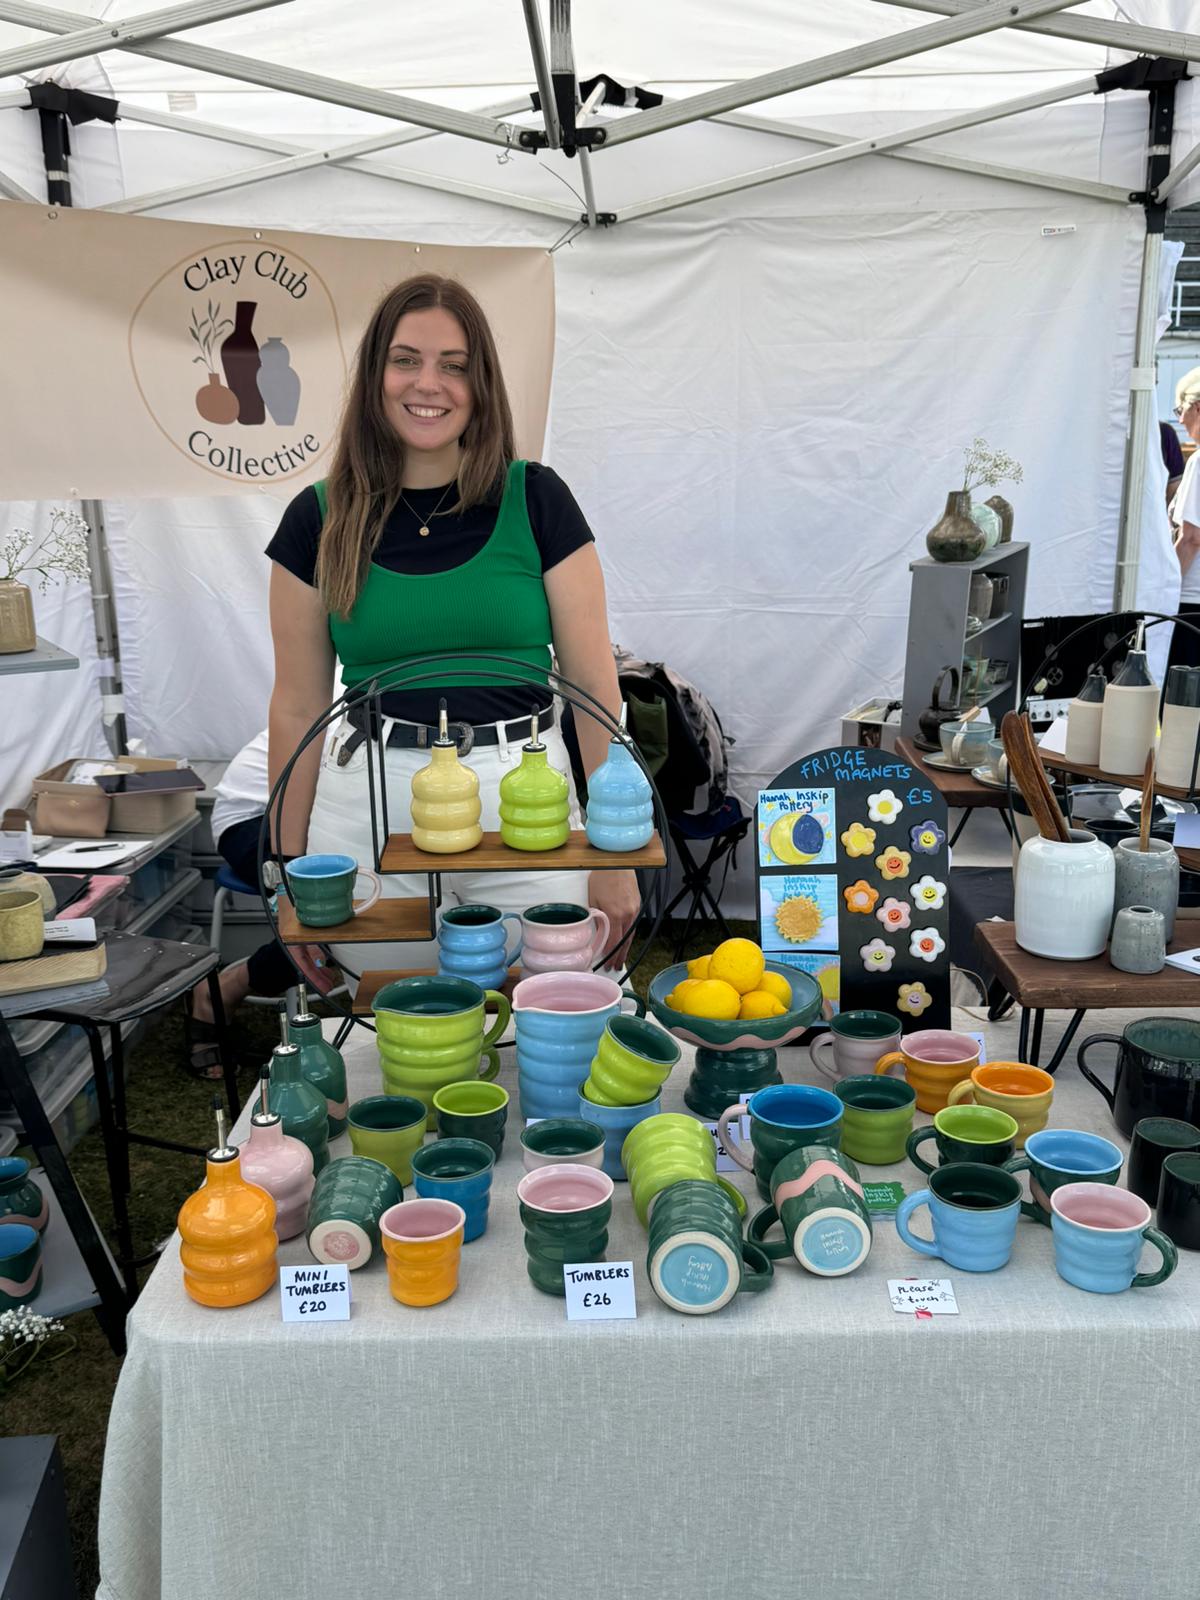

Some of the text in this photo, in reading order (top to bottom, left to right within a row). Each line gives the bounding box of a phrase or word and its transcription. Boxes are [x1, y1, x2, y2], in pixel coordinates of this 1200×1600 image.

[184, 250, 310, 299] Clay Club
[188, 430, 320, 477] Collective
[800, 750, 866, 779] FRIDGE
[834, 764, 912, 781] MAGNETS
[760, 792, 791, 803] Hannah
[294, 1269, 328, 1283] MINI
[566, 1267, 630, 1284] TUMBLERS
[285, 1281, 346, 1297] TUMBLERS
[583, 1292, 612, 1308] £26
